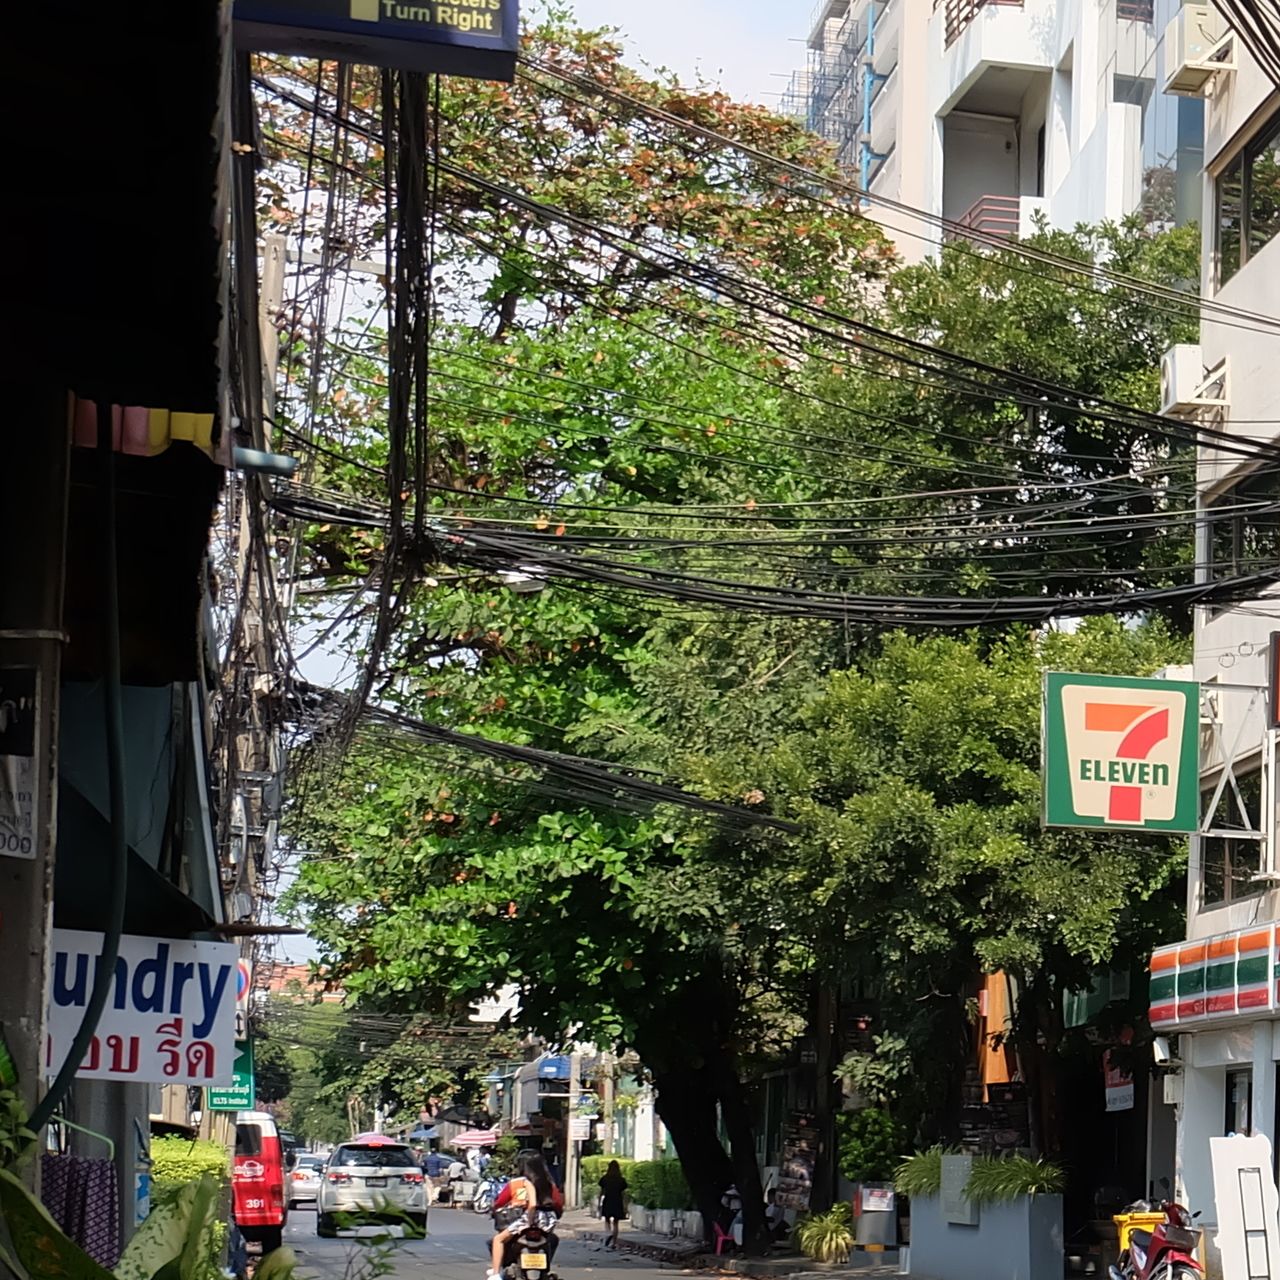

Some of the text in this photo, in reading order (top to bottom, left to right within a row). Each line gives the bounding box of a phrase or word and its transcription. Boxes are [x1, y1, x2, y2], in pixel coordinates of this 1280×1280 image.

[382, 0, 493, 31] Turn Right
[156, 1017, 216, 1079] รีด
